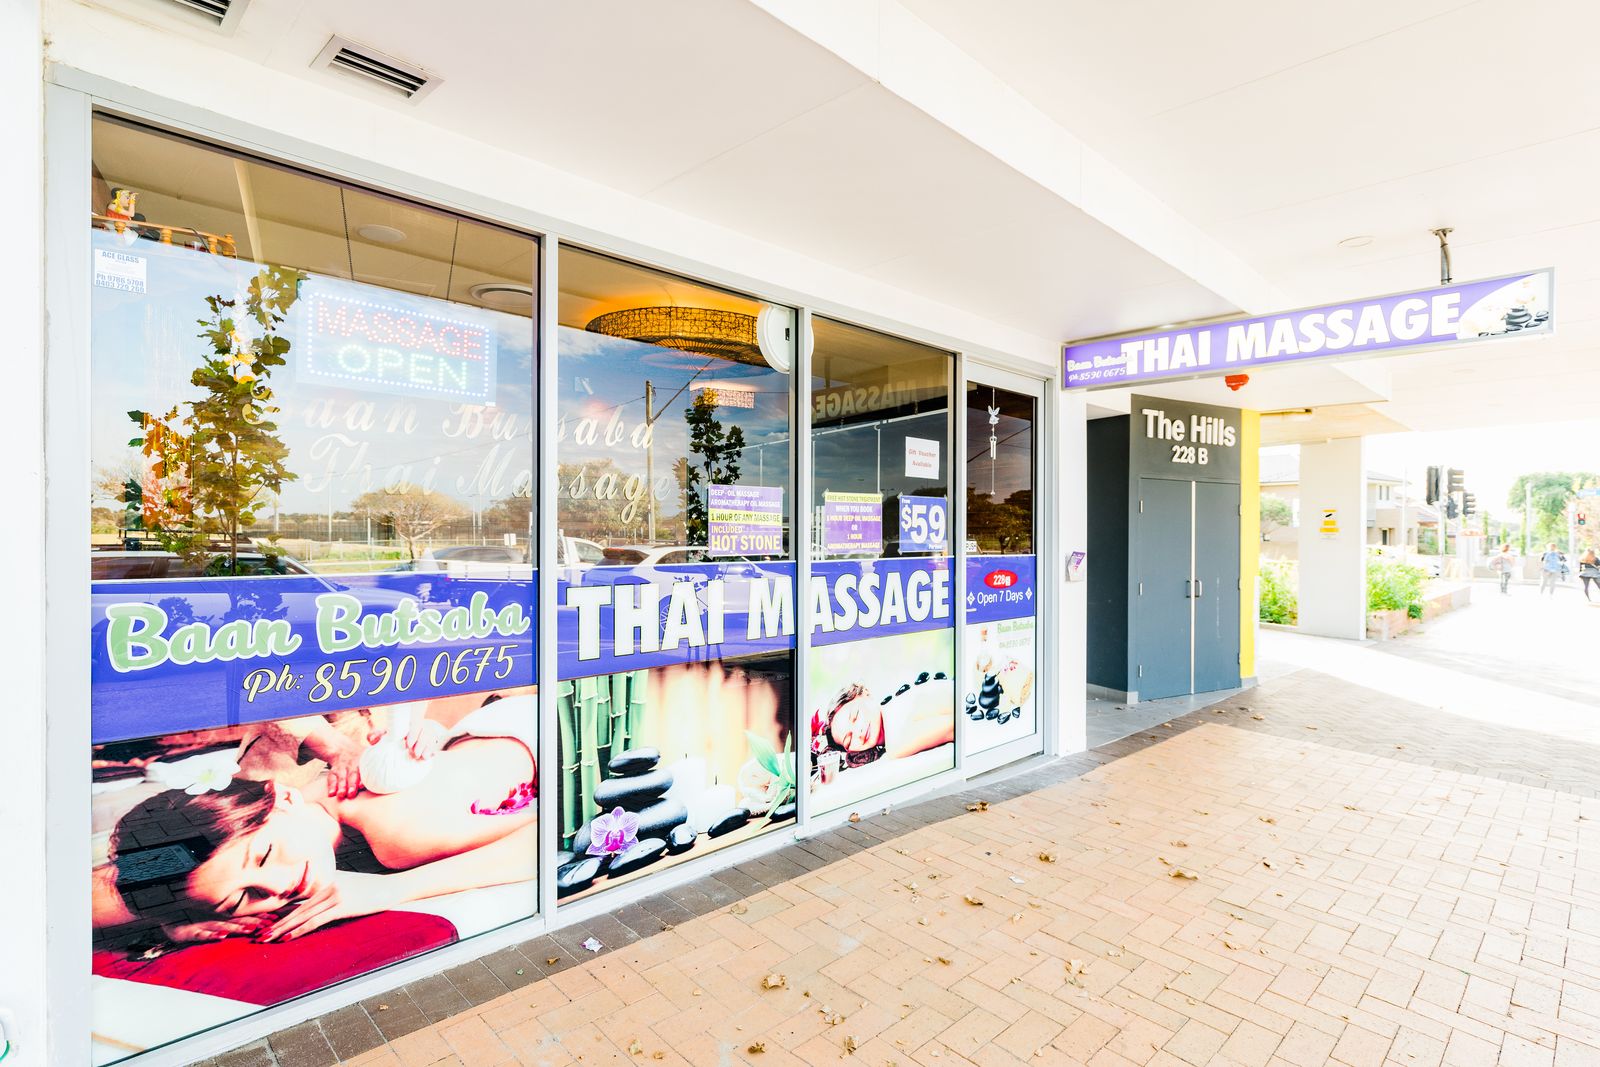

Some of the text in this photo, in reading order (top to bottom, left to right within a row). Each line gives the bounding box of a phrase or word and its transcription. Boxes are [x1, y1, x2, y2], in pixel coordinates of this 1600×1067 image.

[317, 301, 483, 360] MASSAGE
[1120, 292, 1461, 376] THAI MASSAGE
[337, 344, 468, 390] OPEN
[442, 402, 655, 449] Busaba
[1142, 408, 1236, 447] The Hills
[1172, 445, 1209, 465] 228 B
[303, 432, 672, 524] Thai Masage
[737, 490, 759, 498] MASSAGE
[711, 525, 743, 533] INCLUDED
[716, 513, 733, 521] HOUR
[734, 513, 742, 521] OF
[754, 514, 780, 522] MASSAGE
[901, 504, 946, 544] $59
[711, 535, 781, 551] HOT STONE
[566, 569, 951, 662] THAI MASSAGE
[977, 589, 1023, 606] Open 7 Days
[105, 591, 530, 673] Baan Butsaba
[242, 644, 519, 703] Ph: 8590 0675
